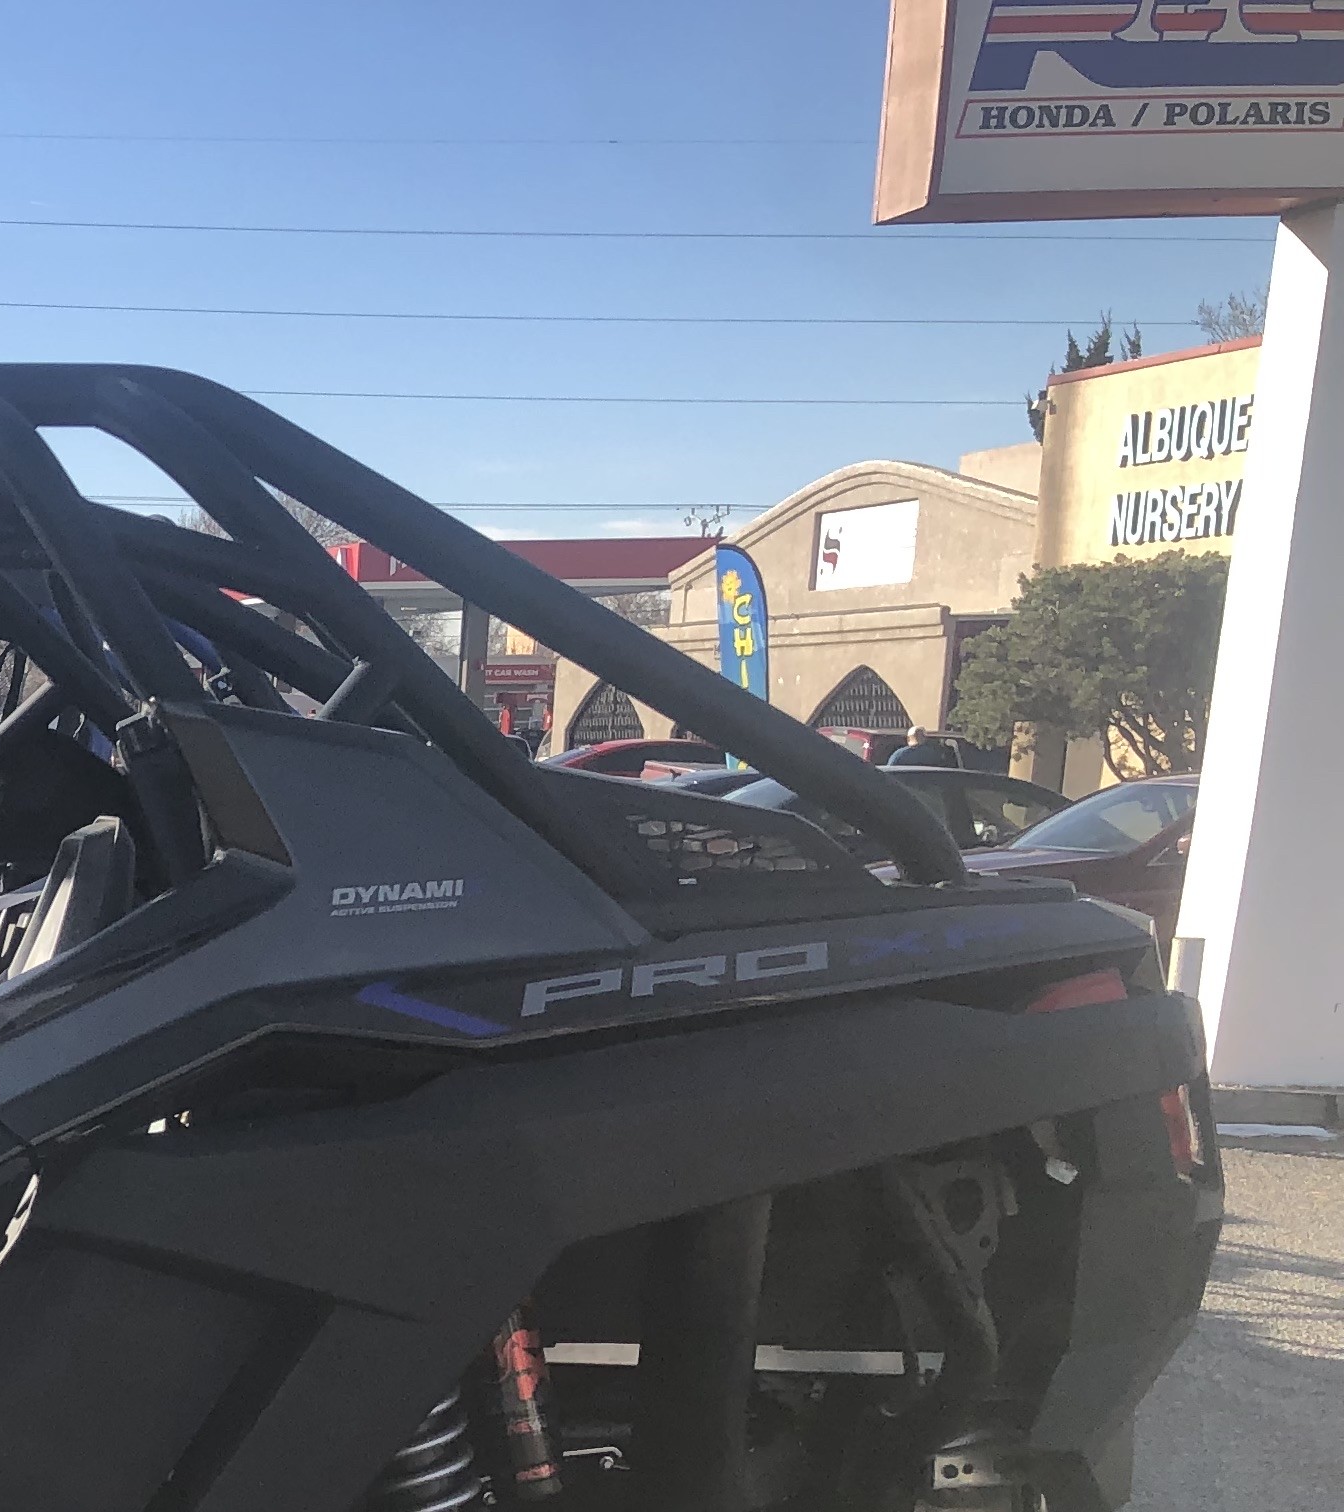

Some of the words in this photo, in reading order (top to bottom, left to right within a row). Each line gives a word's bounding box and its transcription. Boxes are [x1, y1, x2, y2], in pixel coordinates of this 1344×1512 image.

[978, 104, 1116, 130] HONDA
[1132, 103, 1150, 127] /
[1163, 101, 1331, 126] POLARIS
[1118, 394, 1255, 468] ALBUQUE
[1110, 479, 1244, 547] NURSERY
[494, 669, 512, 677] CAR
[329, 906, 375, 917] ACTIVE
[378, 901, 459, 913] SUSPENSION
[520, 941, 830, 1018] PRO
